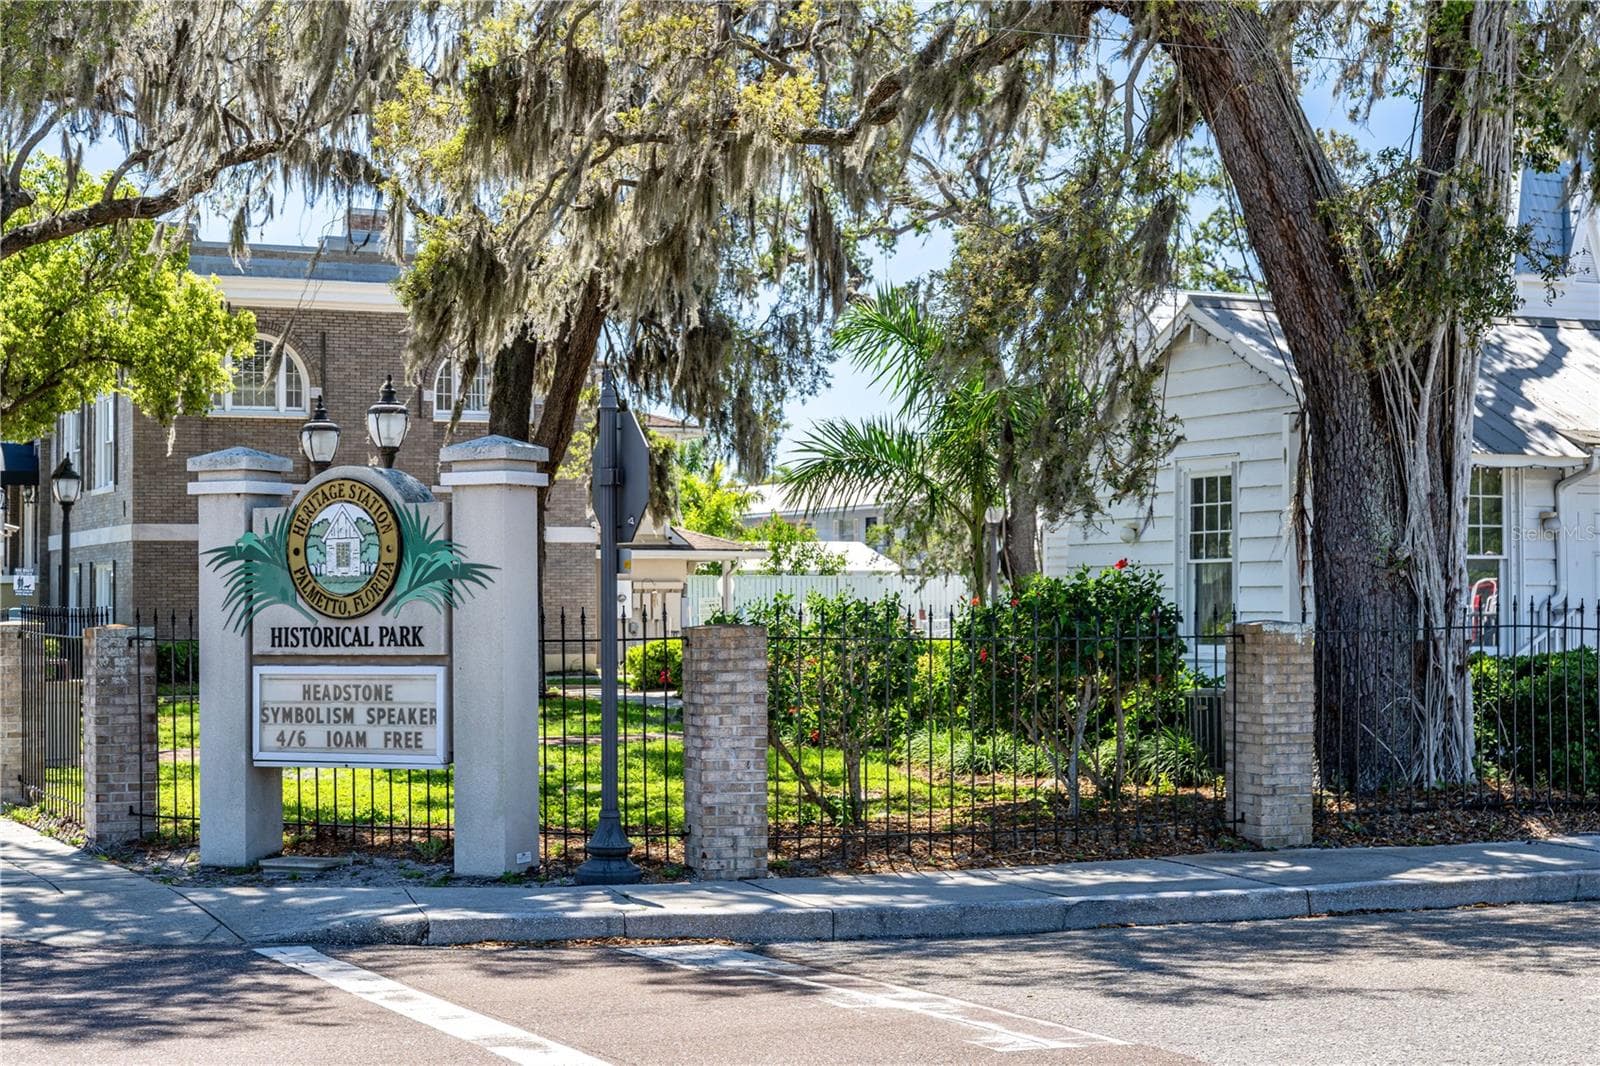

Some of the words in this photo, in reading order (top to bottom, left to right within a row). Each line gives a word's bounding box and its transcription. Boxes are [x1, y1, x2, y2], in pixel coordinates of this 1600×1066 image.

[293, 483, 345, 537] HERITAGE
[348, 484, 393, 534] STATION
[294, 566, 352, 617] PALMETTO,
[354, 562, 395, 606] FLORIDA
[270, 626, 374, 648] HISTORICAL
[379, 625, 424, 648] PARK
[302, 684, 393, 701] HEADSTONE
[261, 706, 354, 724] SYMBOLISM
[366, 707, 437, 725] SPEAKER
[276, 730, 306, 747] 4/6
[384, 731, 423, 749] FREE
